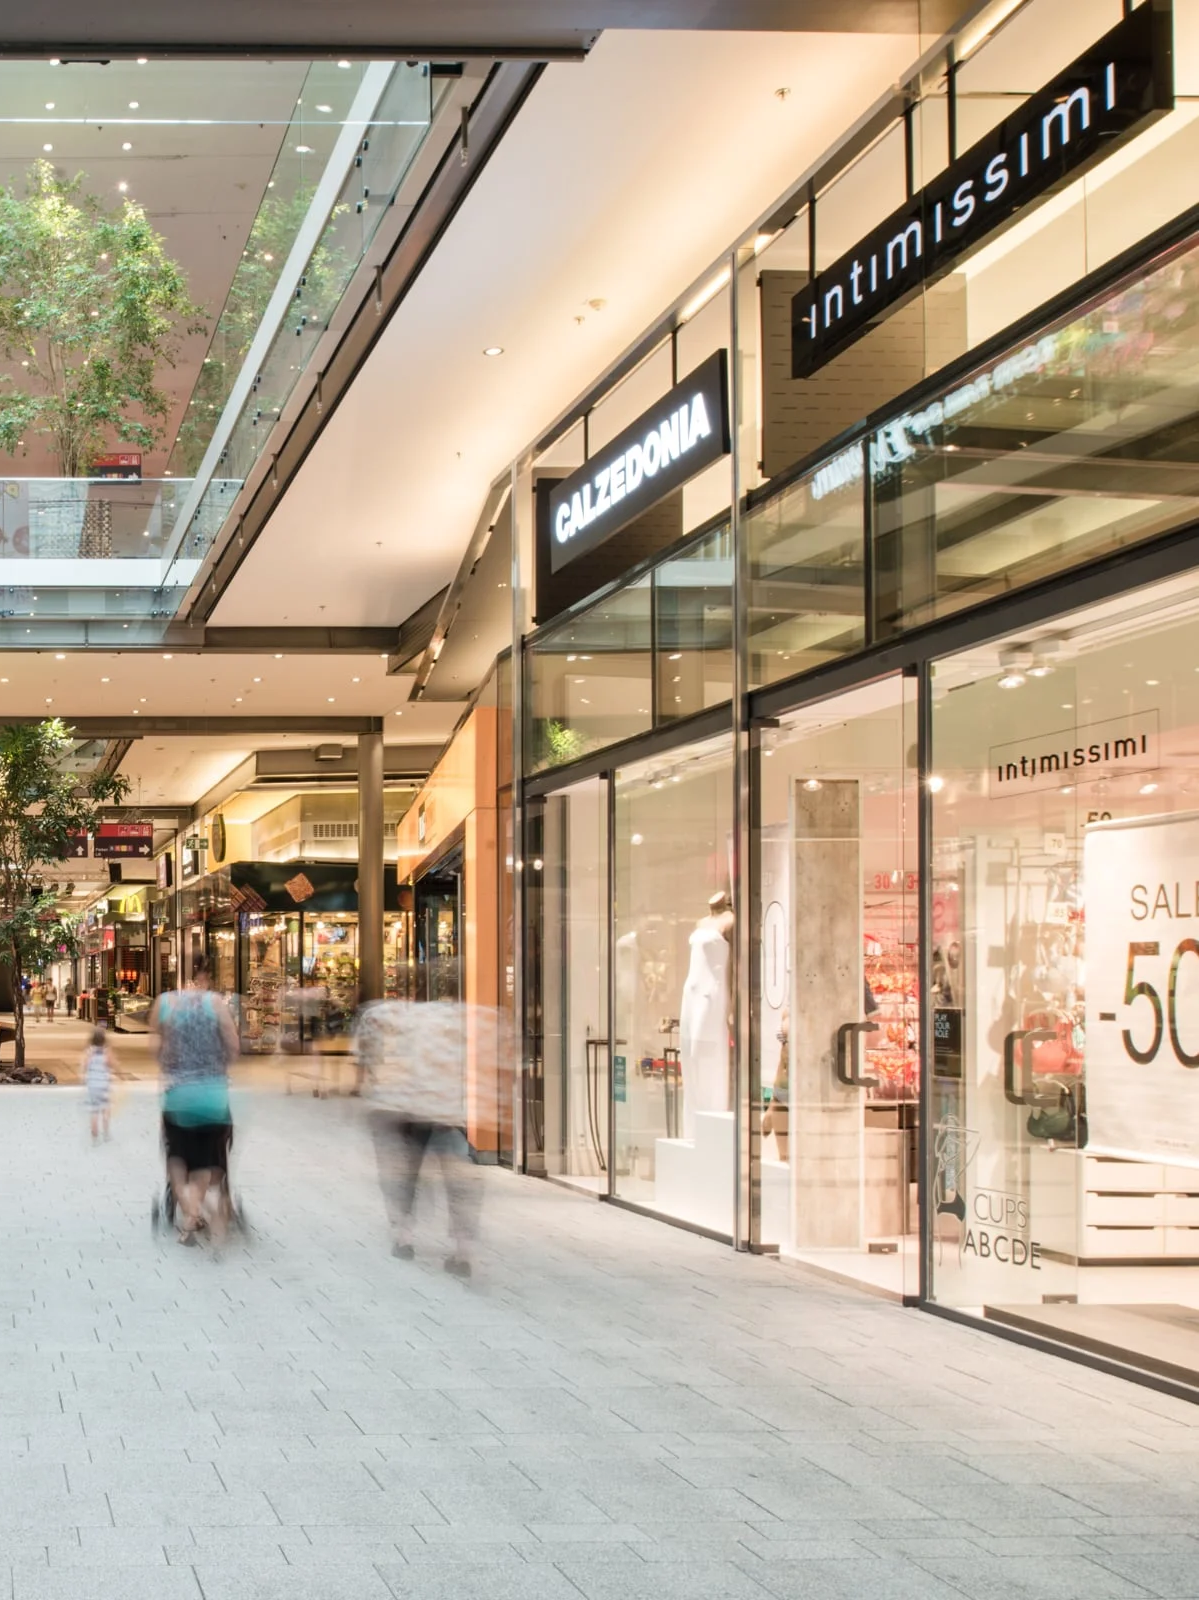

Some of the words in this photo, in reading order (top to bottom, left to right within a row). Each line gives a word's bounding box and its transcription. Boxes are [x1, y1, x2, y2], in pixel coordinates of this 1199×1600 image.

[809, 61, 1117, 340] intimissimi
[555, 393, 713, 545] CALZEDONIA
[997, 734, 1147, 782] intimissimi
[1130, 878, 1199, 921] SAL
[973, 1193, 1028, 1229] CUPS
[963, 1229, 1041, 1270] ABCDE
